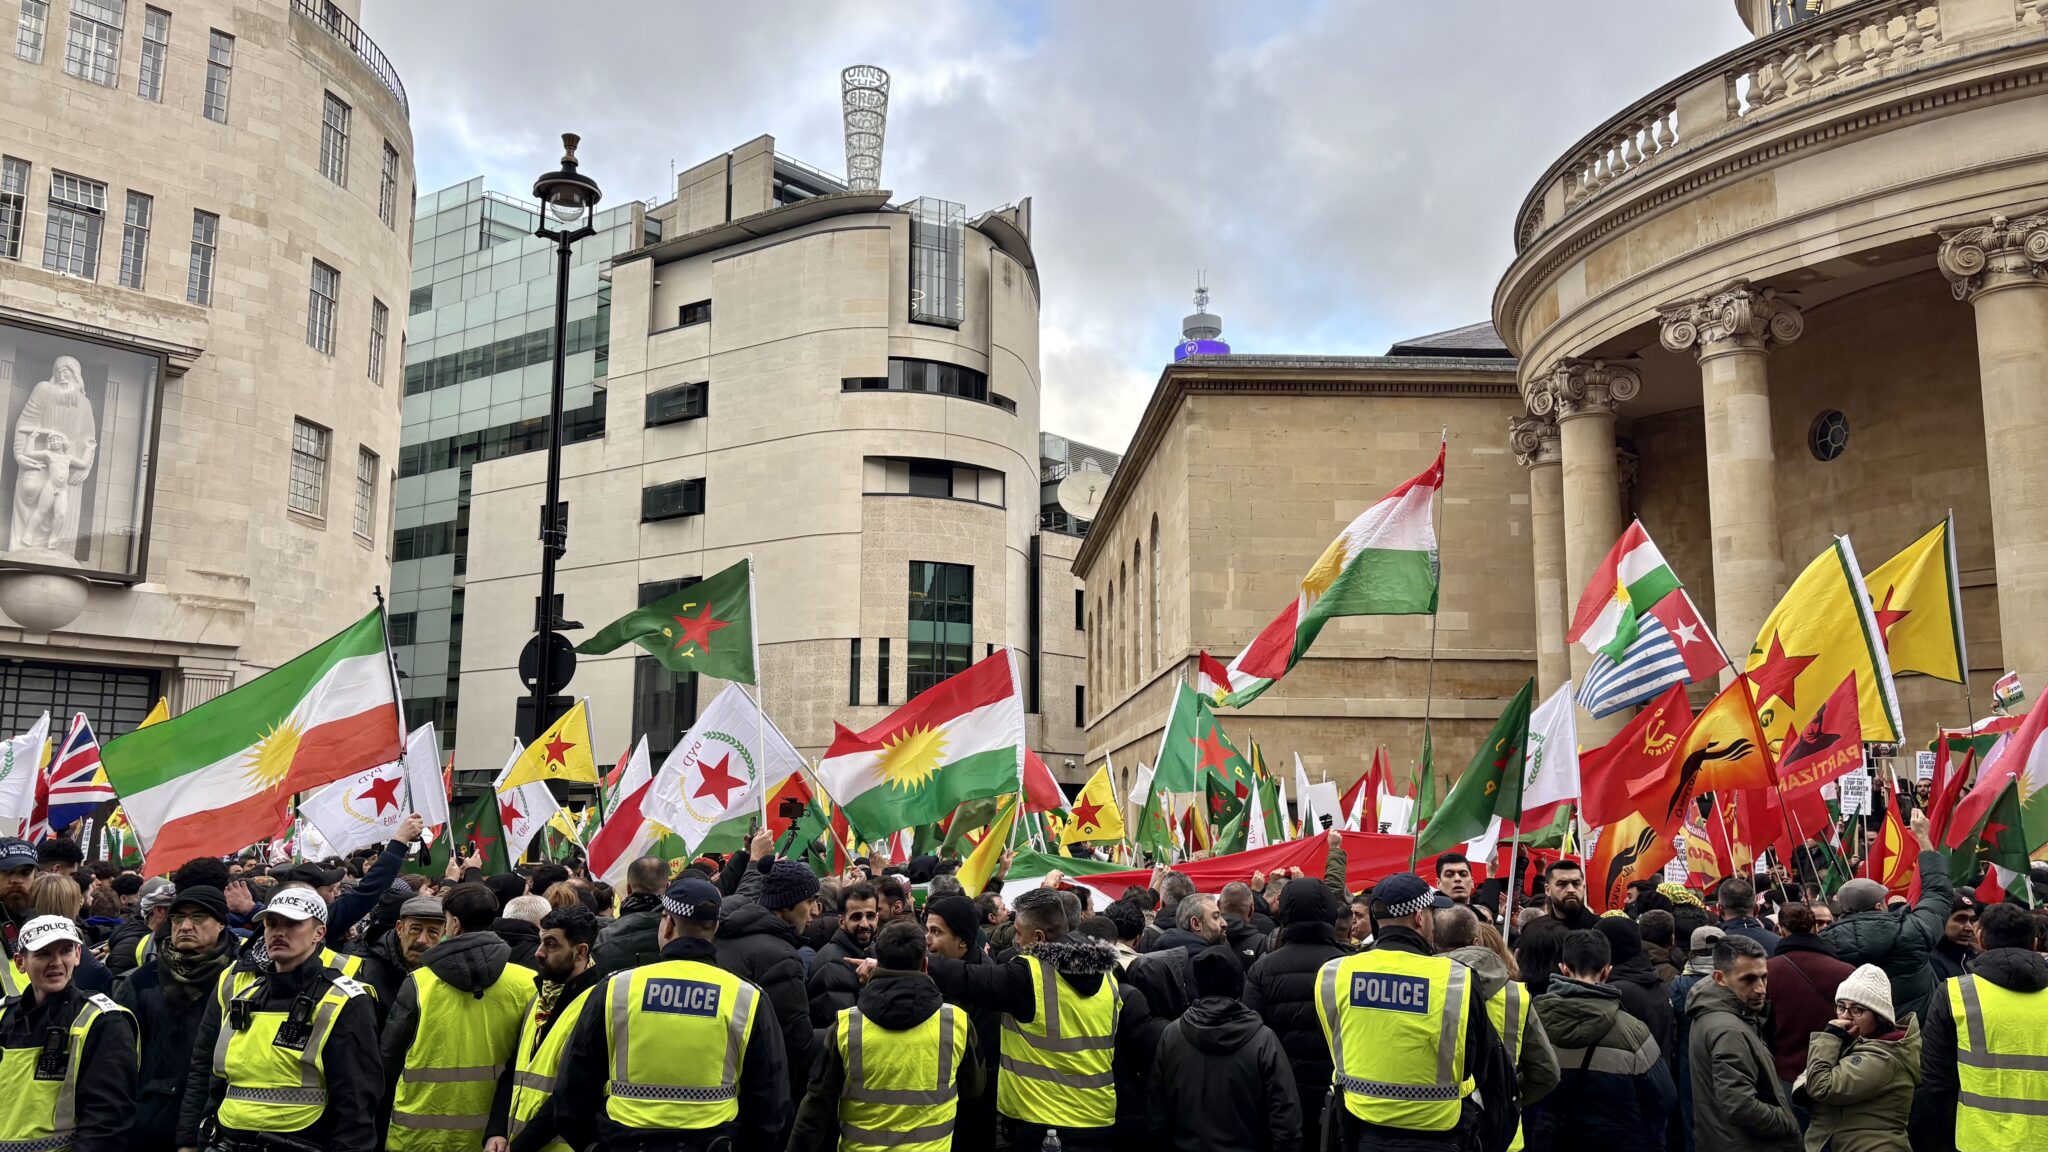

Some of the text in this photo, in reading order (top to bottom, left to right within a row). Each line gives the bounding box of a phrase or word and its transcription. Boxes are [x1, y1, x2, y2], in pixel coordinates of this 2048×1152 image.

[271, 896, 300, 906] POLICE
[36, 922, 69, 935] POLICE
[647, 983, 717, 1011] POLICE
[1353, 977, 1425, 1007] POLICE
